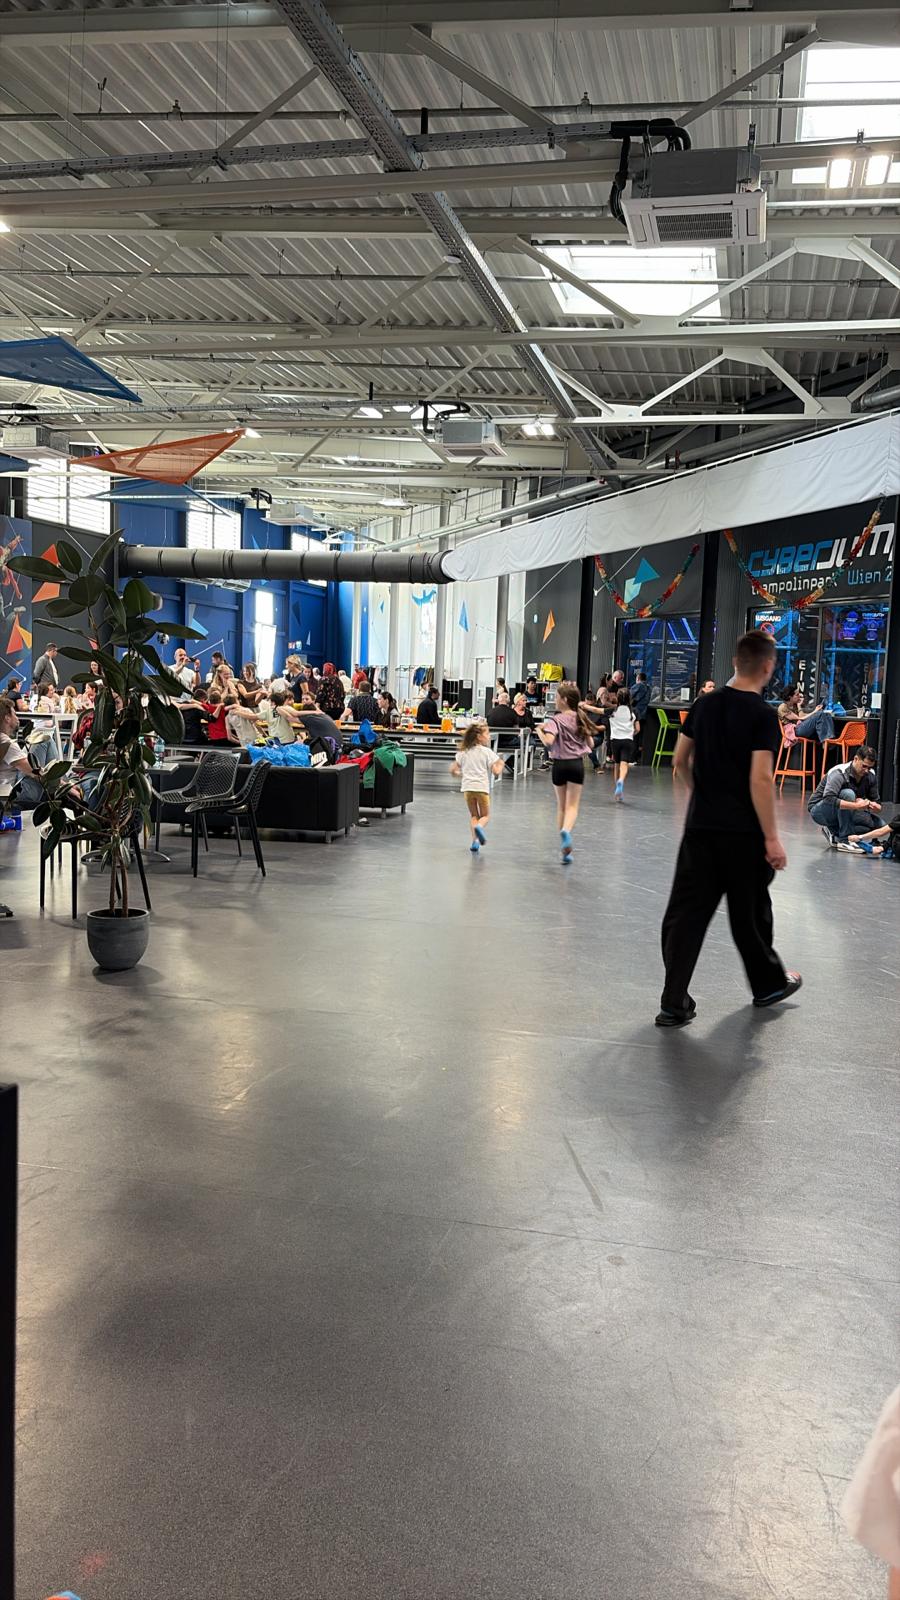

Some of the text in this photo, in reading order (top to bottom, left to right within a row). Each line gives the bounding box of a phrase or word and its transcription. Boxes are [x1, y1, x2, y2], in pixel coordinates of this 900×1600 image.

[747, 522, 895, 577] CYBERJUM
[751, 572, 838, 595] tampolinpar
[847, 569, 882, 585] Wien
[797, 659, 807, 698] EIN
